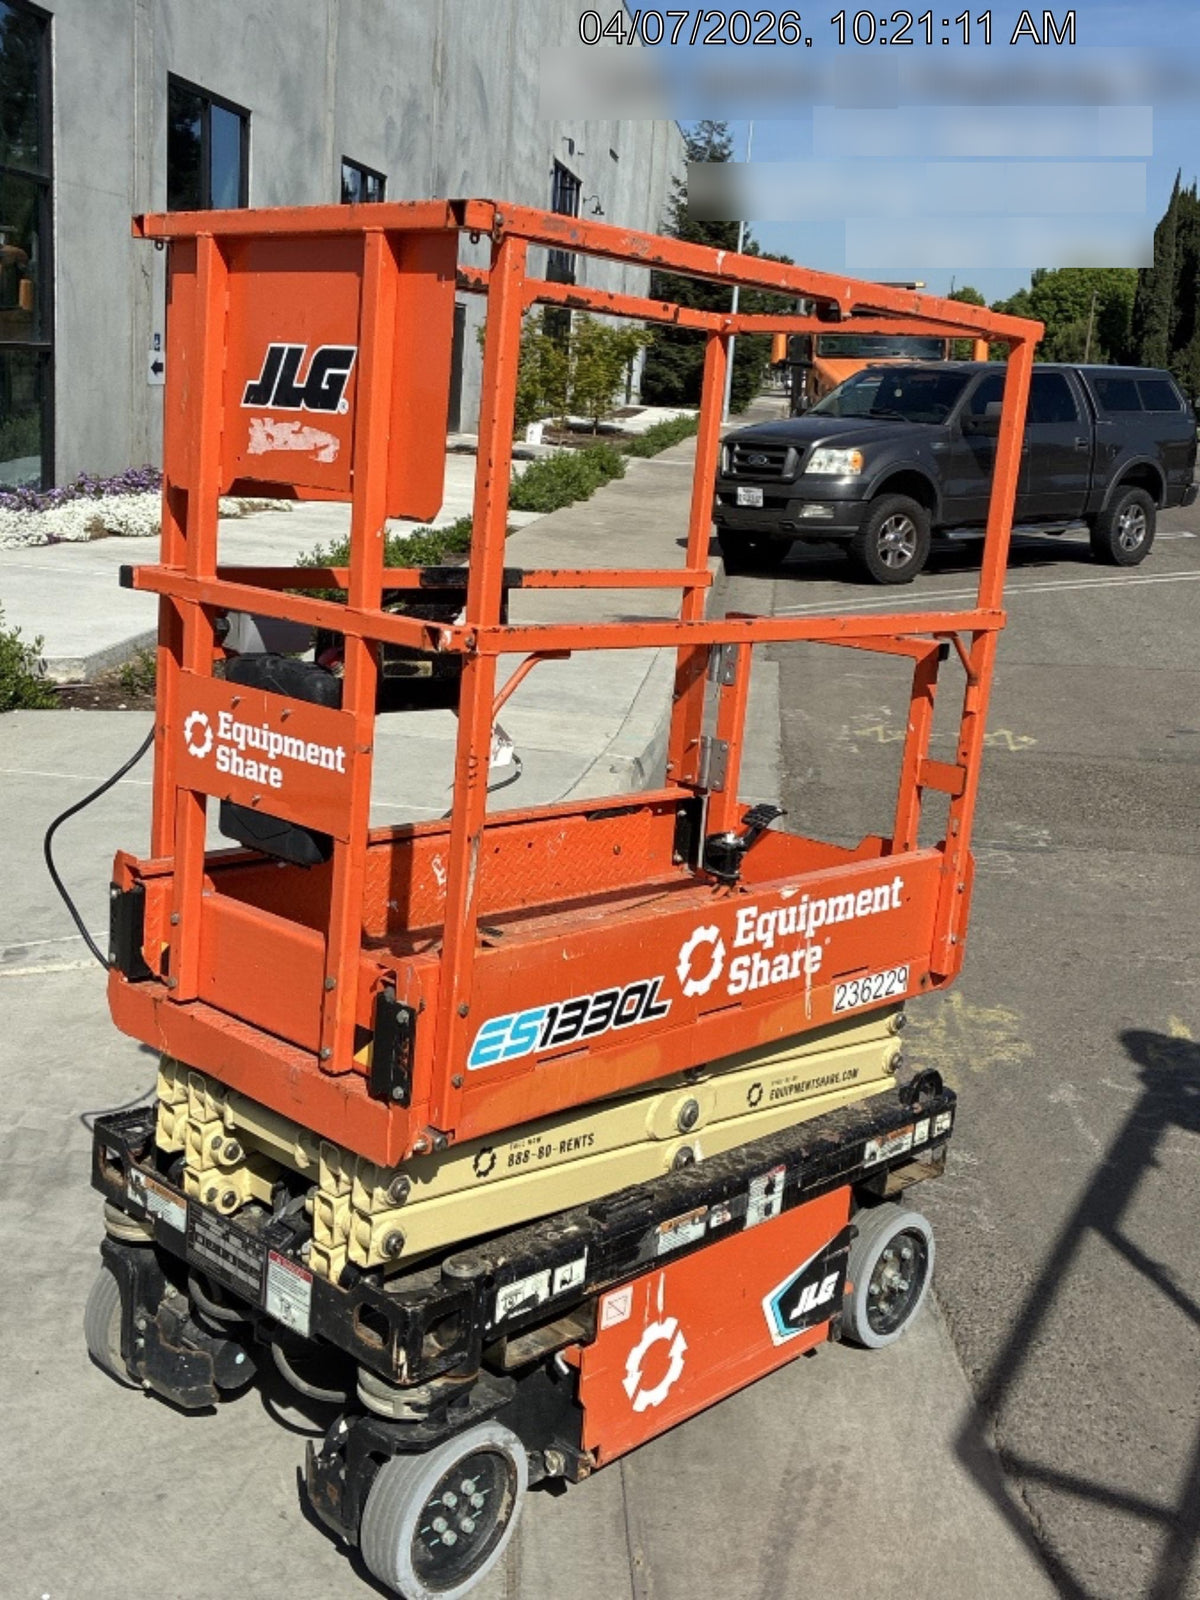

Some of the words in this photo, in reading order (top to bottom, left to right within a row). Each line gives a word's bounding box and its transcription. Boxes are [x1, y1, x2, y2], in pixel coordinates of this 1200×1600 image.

[240, 342, 357, 414] JLG
[215, 745, 283, 788] Share
[217, 711, 346, 774] Equipment
[733, 876, 904, 949] Equipment
[727, 943, 822, 995] Share
[834, 966, 908, 1012] 236229
[469, 977, 670, 1068] ES1330L
[769, 1068, 859, 1101] EQUIPMENTSHARE.COM
[507, 1133, 595, 1167] 888-80-RENTS
[789, 1270, 840, 1320] JLG
